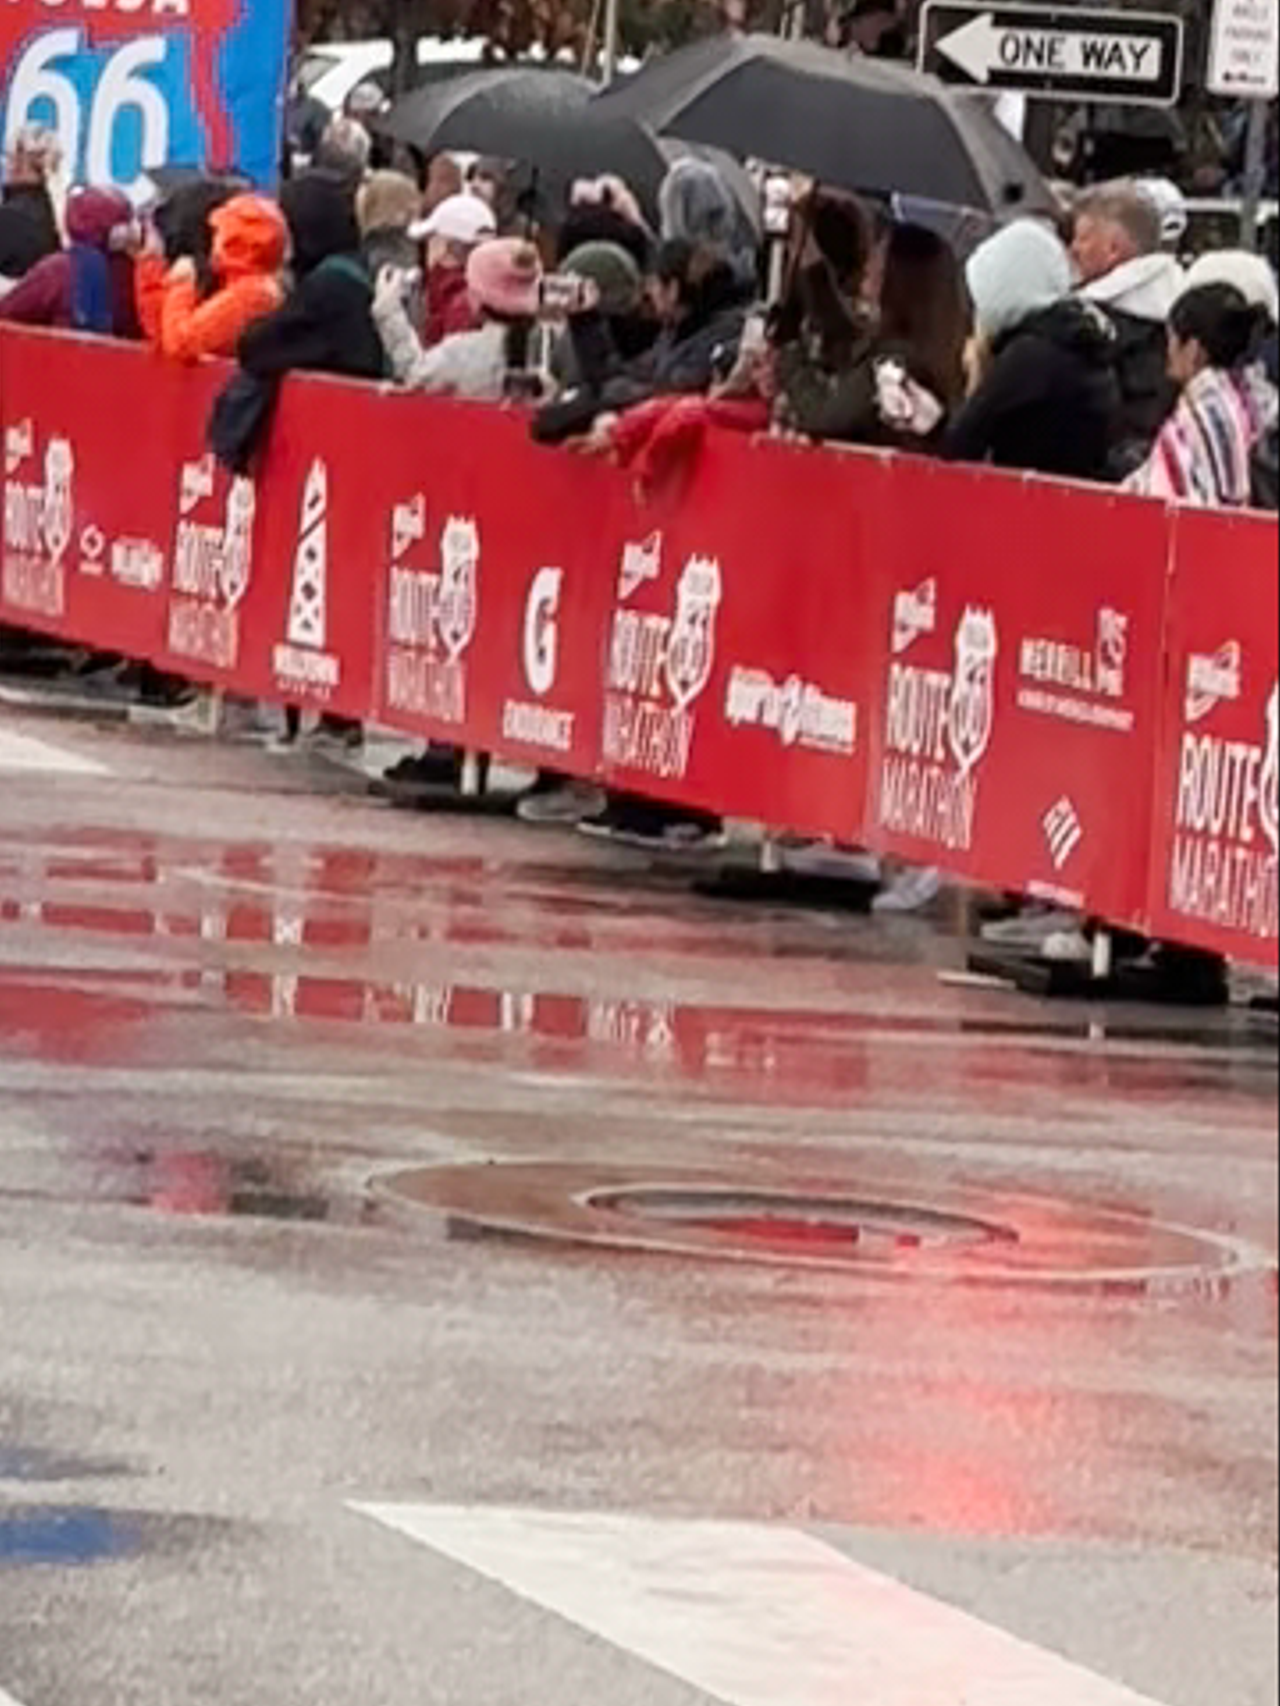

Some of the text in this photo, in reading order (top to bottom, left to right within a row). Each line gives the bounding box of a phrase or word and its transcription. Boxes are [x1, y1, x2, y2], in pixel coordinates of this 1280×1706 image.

[998, 33, 1152, 72] ONE WAY
[3, 26, 168, 208] 66
[1176, 732, 1262, 842] ROUTE
